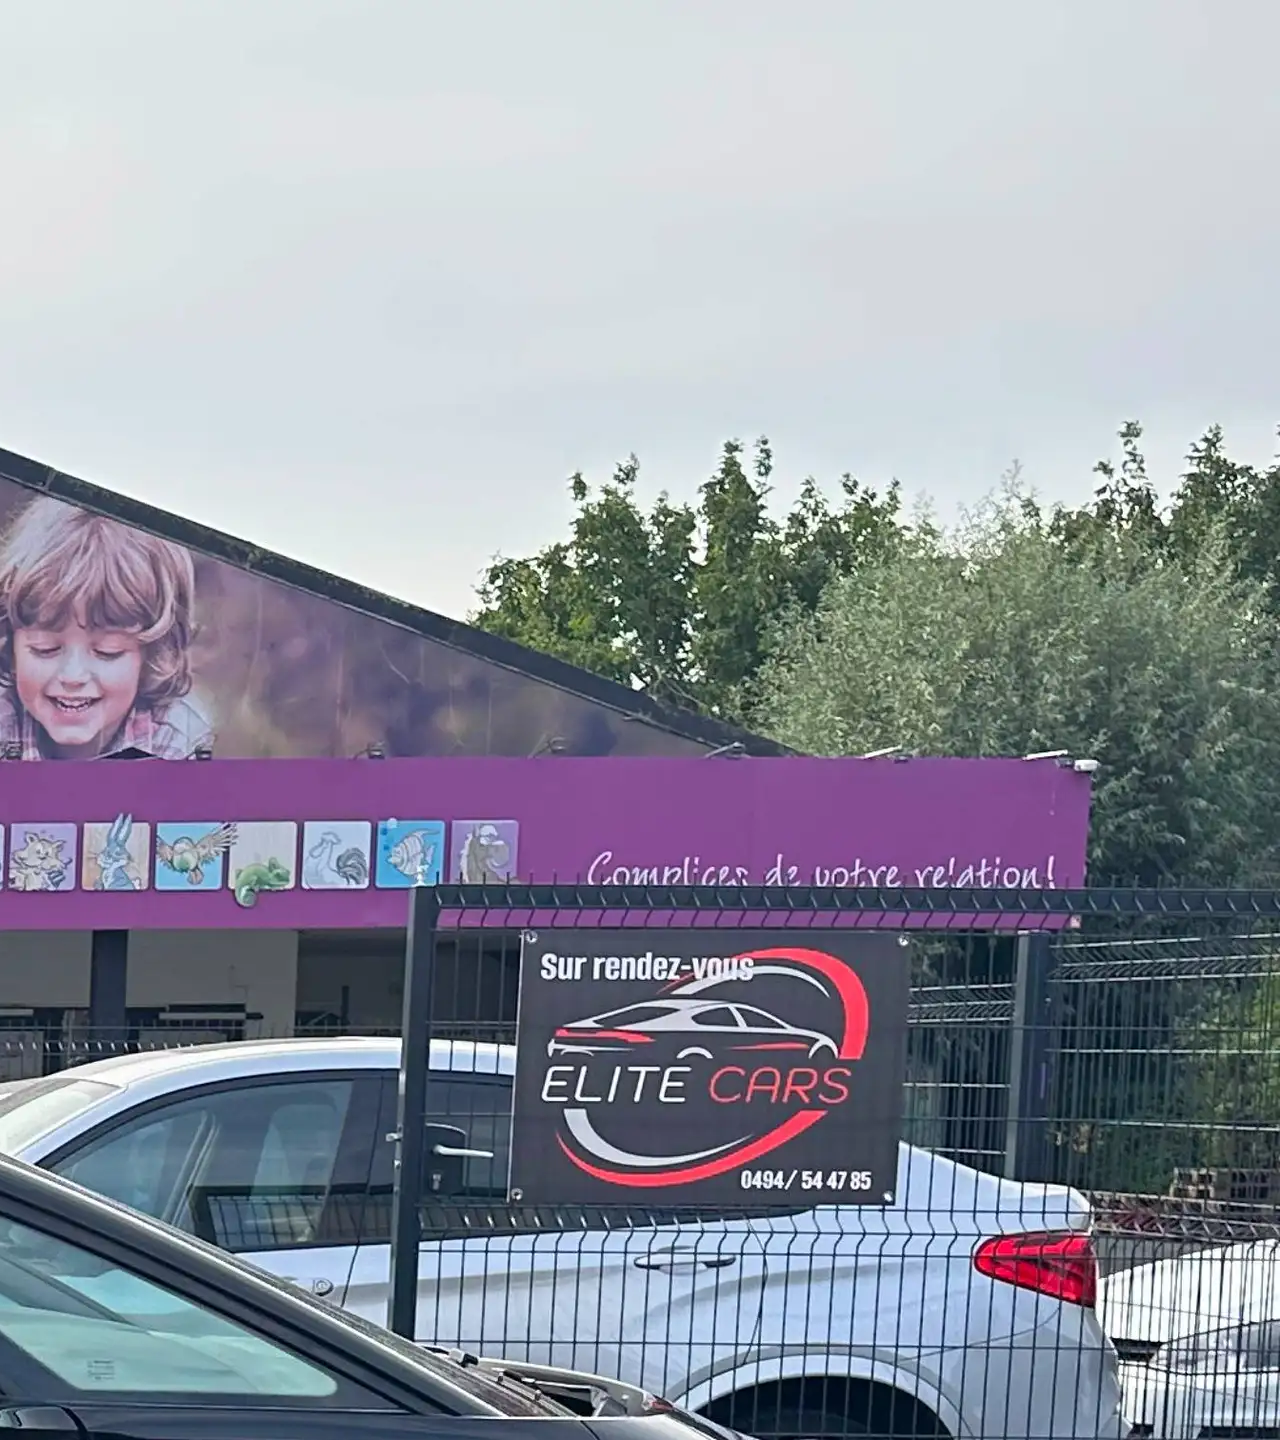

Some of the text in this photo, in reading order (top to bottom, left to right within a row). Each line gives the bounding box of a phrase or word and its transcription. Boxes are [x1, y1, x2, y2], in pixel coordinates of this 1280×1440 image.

[764, 853, 801, 886] de
[814, 858, 902, 887] votre
[540, 952, 755, 982] Sur rendez-vous
[541, 1065, 852, 1104] ELITE CARS
[740, 1170, 872, 1191] 0494/ 54 47 85
